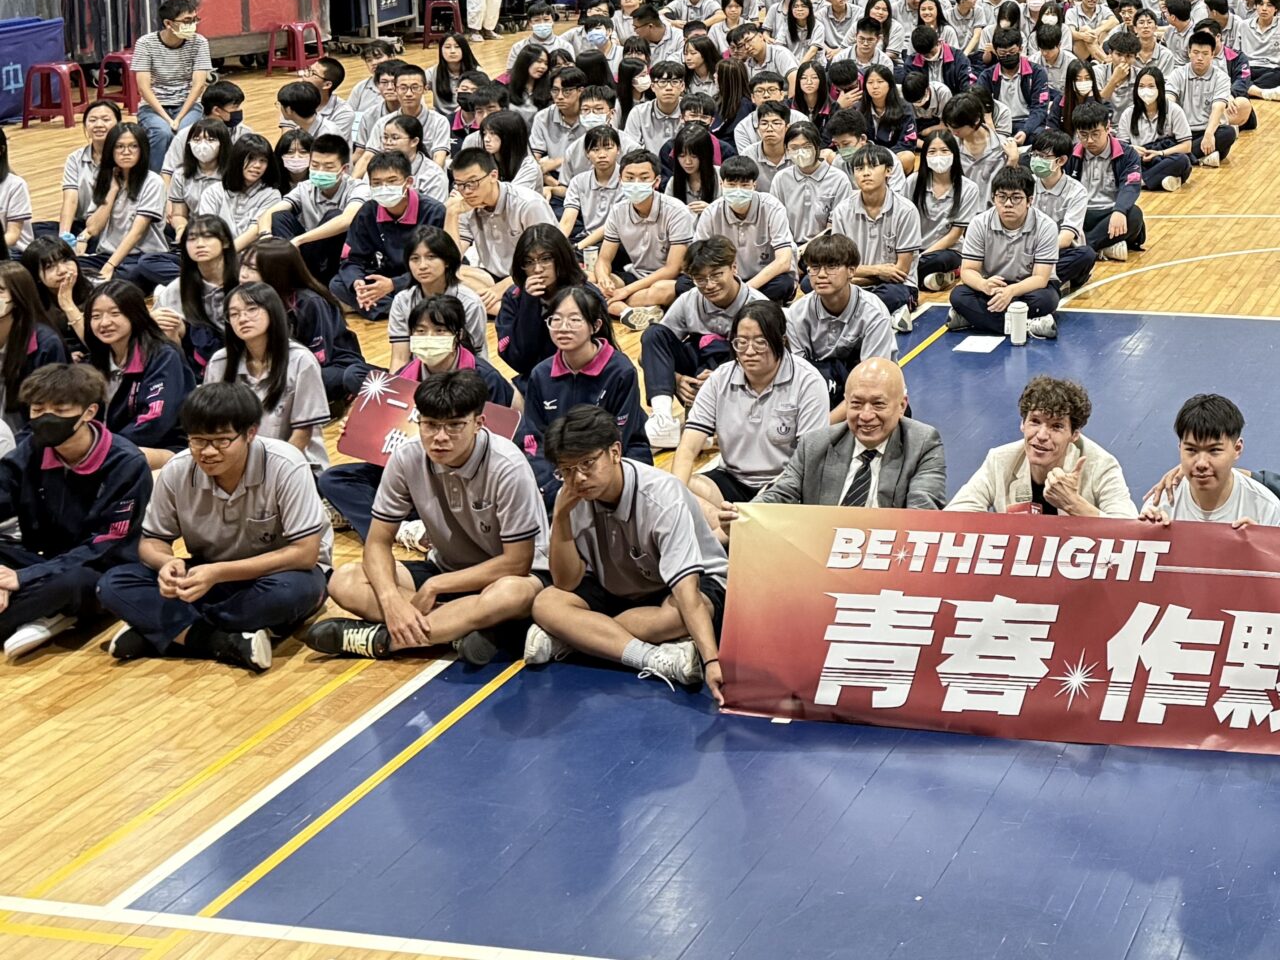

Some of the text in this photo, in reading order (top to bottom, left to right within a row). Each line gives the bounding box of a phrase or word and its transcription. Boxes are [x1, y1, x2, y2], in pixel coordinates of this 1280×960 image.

[826, 528, 1171, 581] BE THE LIGHT
